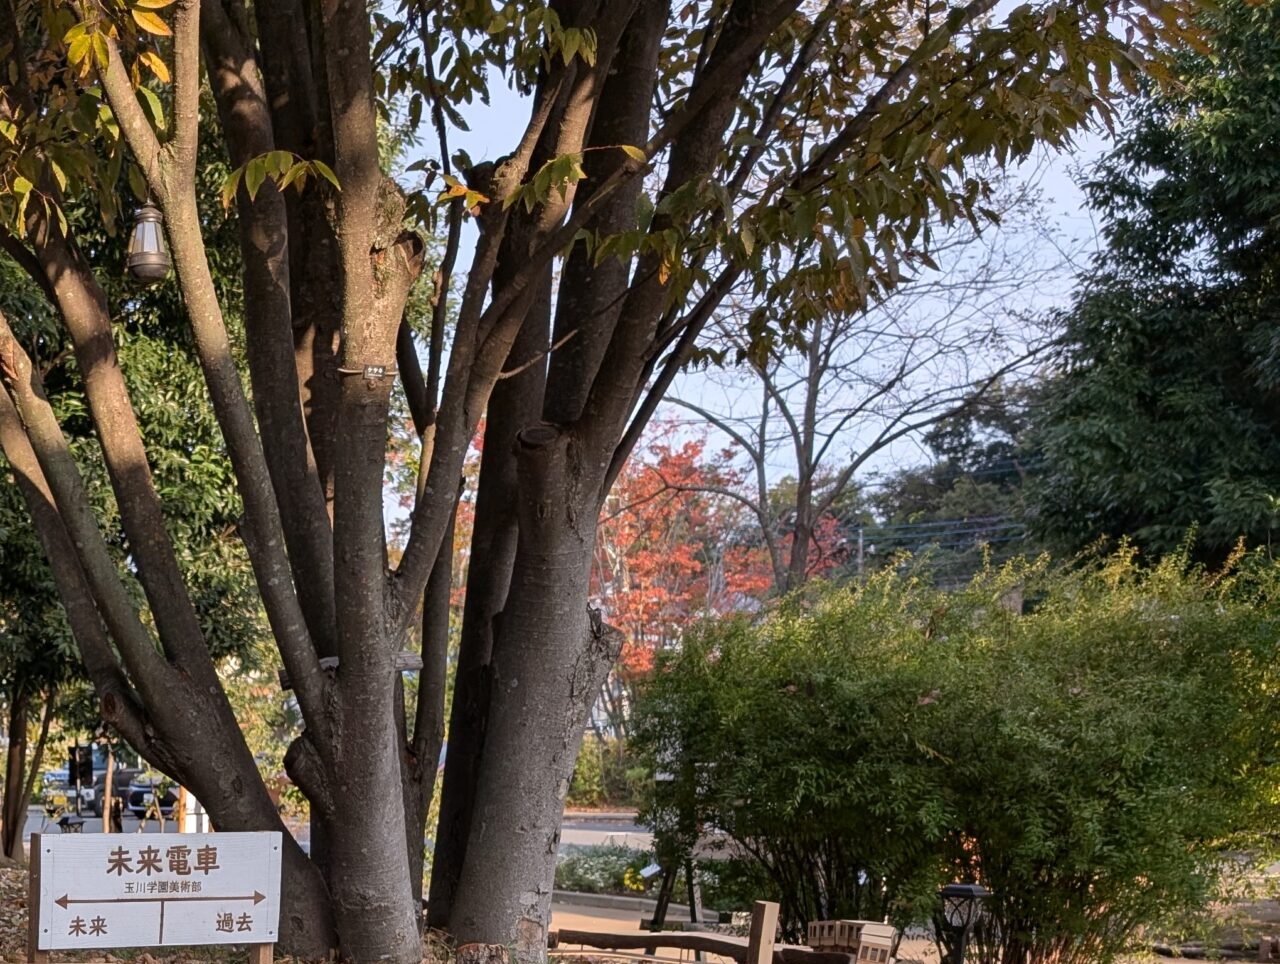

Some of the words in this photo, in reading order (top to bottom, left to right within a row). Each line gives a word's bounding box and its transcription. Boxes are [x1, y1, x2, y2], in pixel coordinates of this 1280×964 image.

[106, 844, 220, 876] 未来電車
[124, 880, 202, 894] 玉川学園美術部
[68, 915, 108, 937] 未来
[215, 912, 254, 933] 過去
